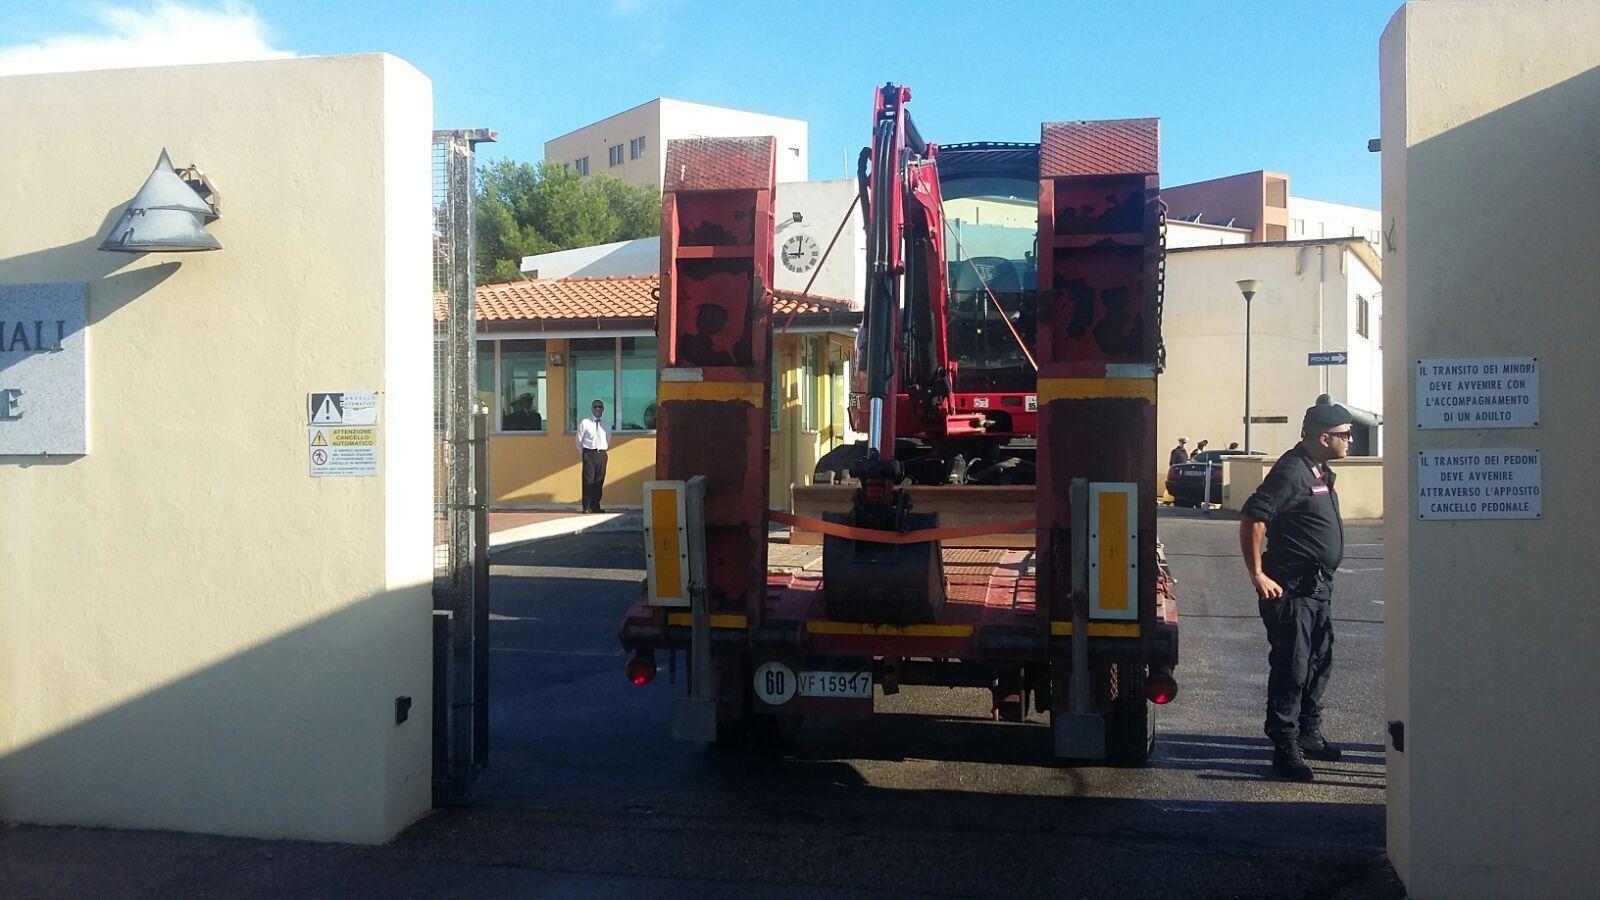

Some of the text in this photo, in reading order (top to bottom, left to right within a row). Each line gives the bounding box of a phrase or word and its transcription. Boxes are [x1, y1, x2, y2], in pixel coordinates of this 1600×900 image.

[1419, 364, 1535, 376] IL TRANSITO DEI MINORI
[1429, 380, 1526, 391] DEVE AVVENIRE CON
[1426, 395, 1529, 407] L'ACCOMPAGNAMENTO
[1443, 411, 1512, 422] DI UN ADULTO
[1421, 455, 1538, 466] IL TRANSITO DEI PEDONI
[1440, 471, 1514, 482] DEVE AVVENIRE
[1420, 486, 1540, 497] ATTRAVERSO L'APPOSITO
[1430, 502, 1530, 513] CANCELLO PEDONALE
[765, 670, 785, 695] 60
[799, 675, 870, 693] VF 15947
